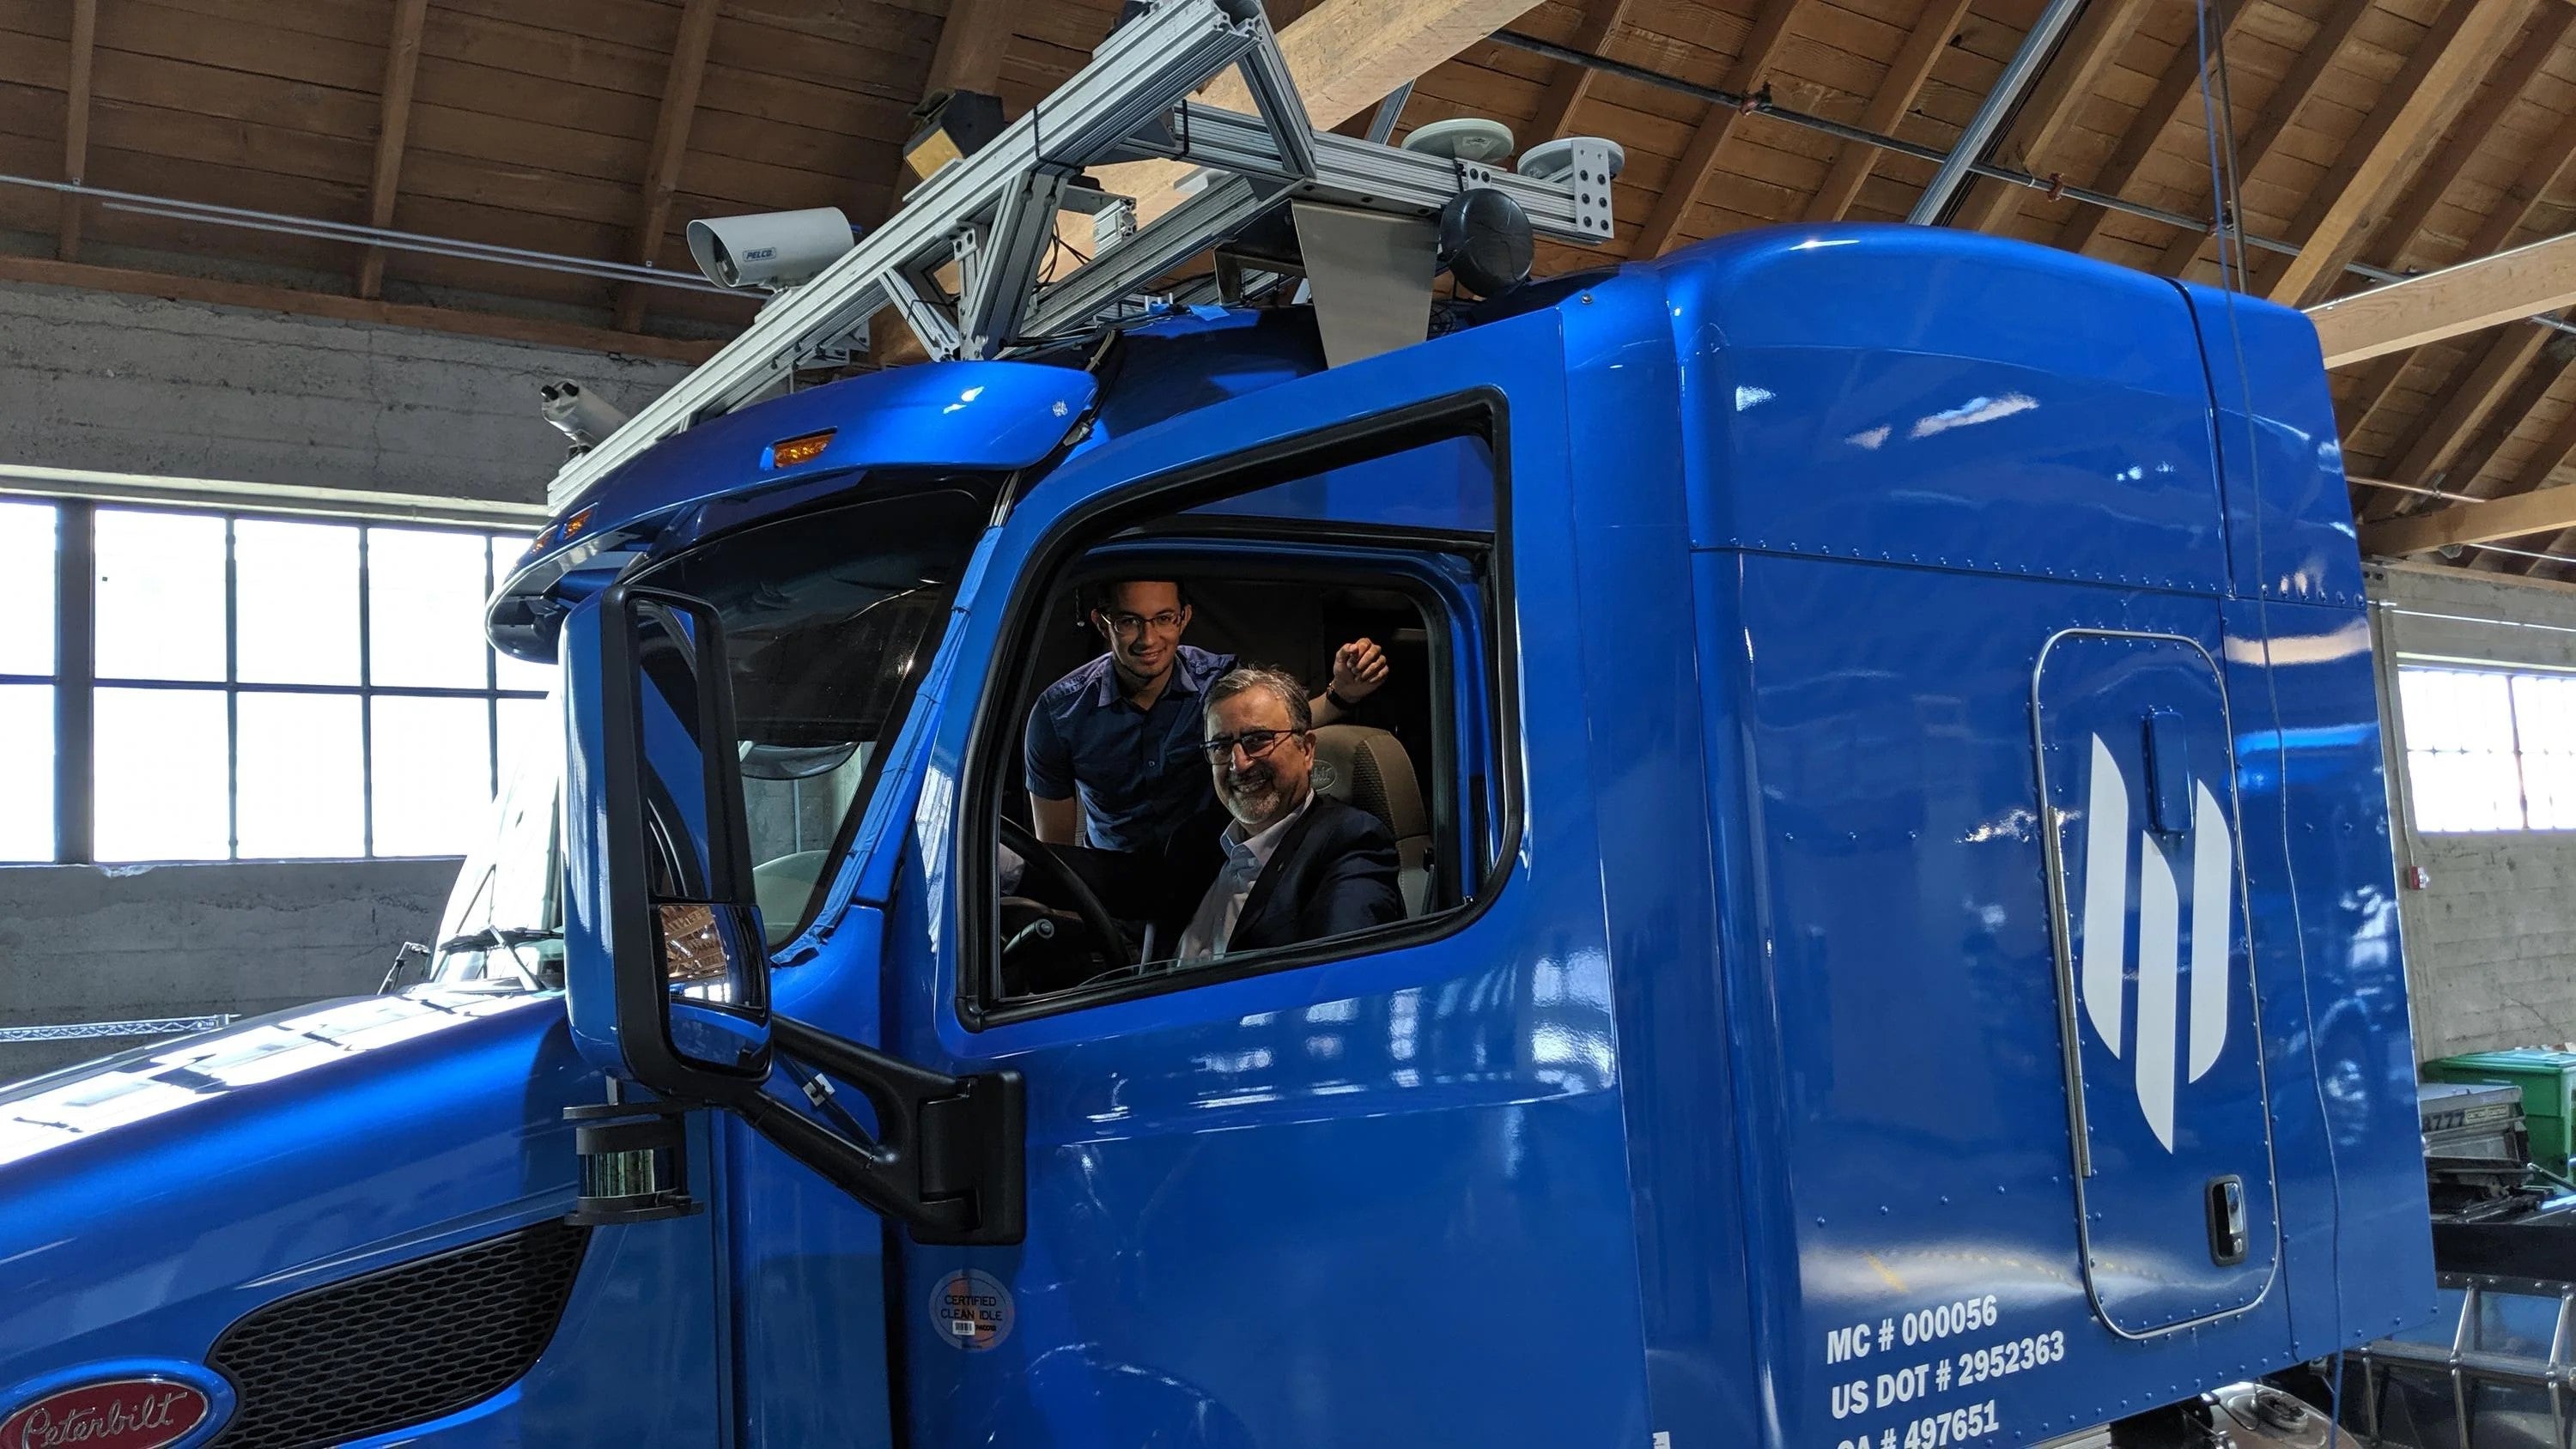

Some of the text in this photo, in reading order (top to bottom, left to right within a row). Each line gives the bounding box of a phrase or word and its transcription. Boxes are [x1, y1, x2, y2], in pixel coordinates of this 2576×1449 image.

[746, 250, 773, 259] PELCO
[940, 1309, 1003, 1321] CLEAN IDLE
[945, 1294, 997, 1307] CERTIFIED
[1827, 1294, 1996, 1364] MC # 000056
[1832, 1331, 2064, 1419] US DOT # 2952363
[21, 1391, 188, 1449] Peterbilt
[1904, 1399, 1999, 1449] 497651
